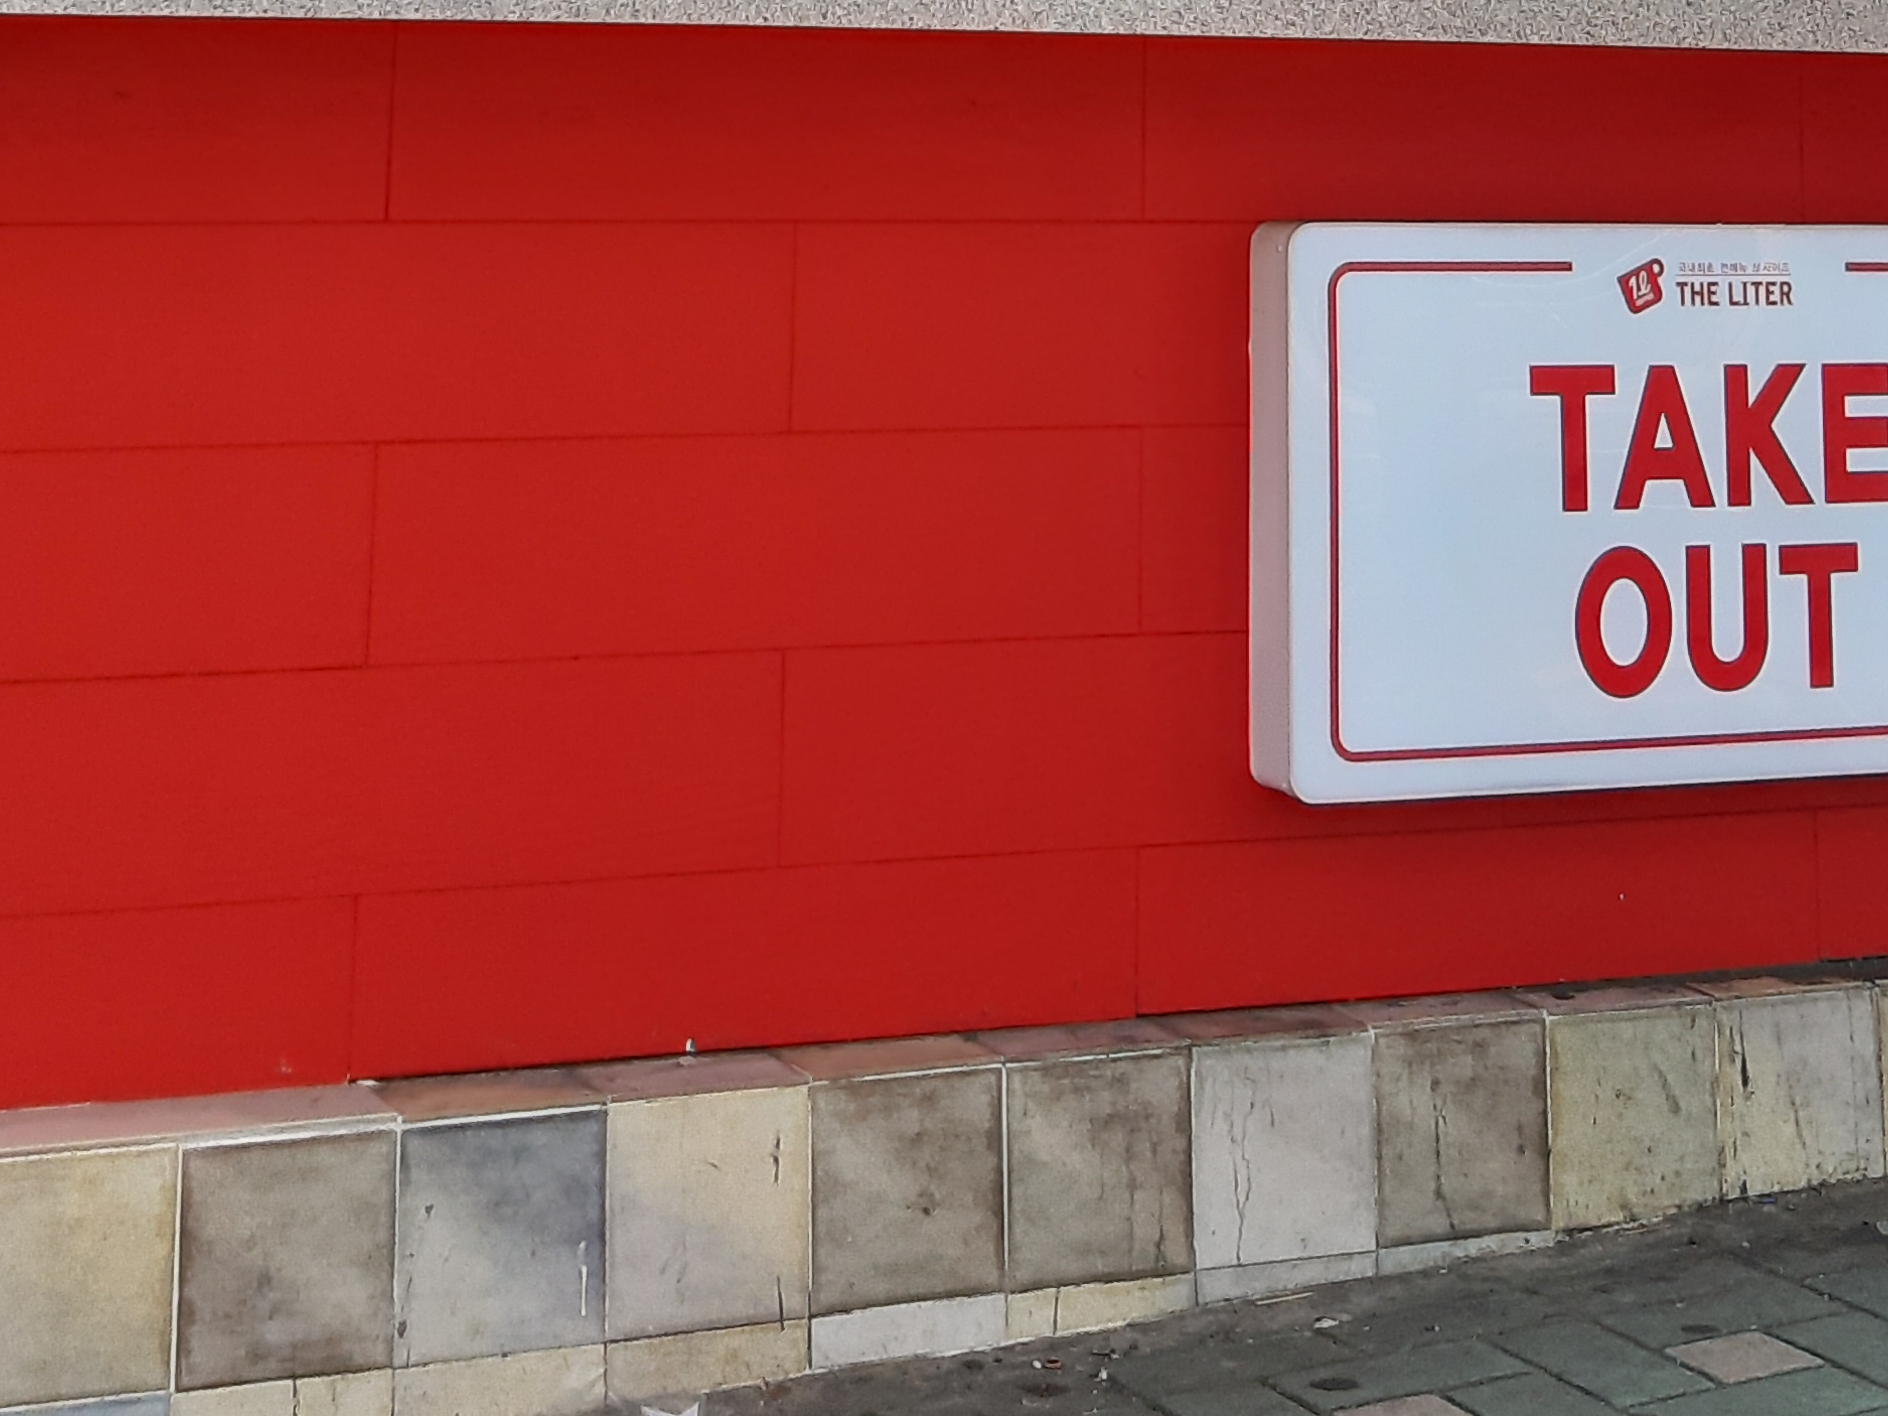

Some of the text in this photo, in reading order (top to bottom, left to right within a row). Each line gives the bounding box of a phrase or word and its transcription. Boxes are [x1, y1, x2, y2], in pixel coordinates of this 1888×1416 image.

[1675, 280, 1794, 307] THE LITER
[1573, 539, 1861, 700] OUT
